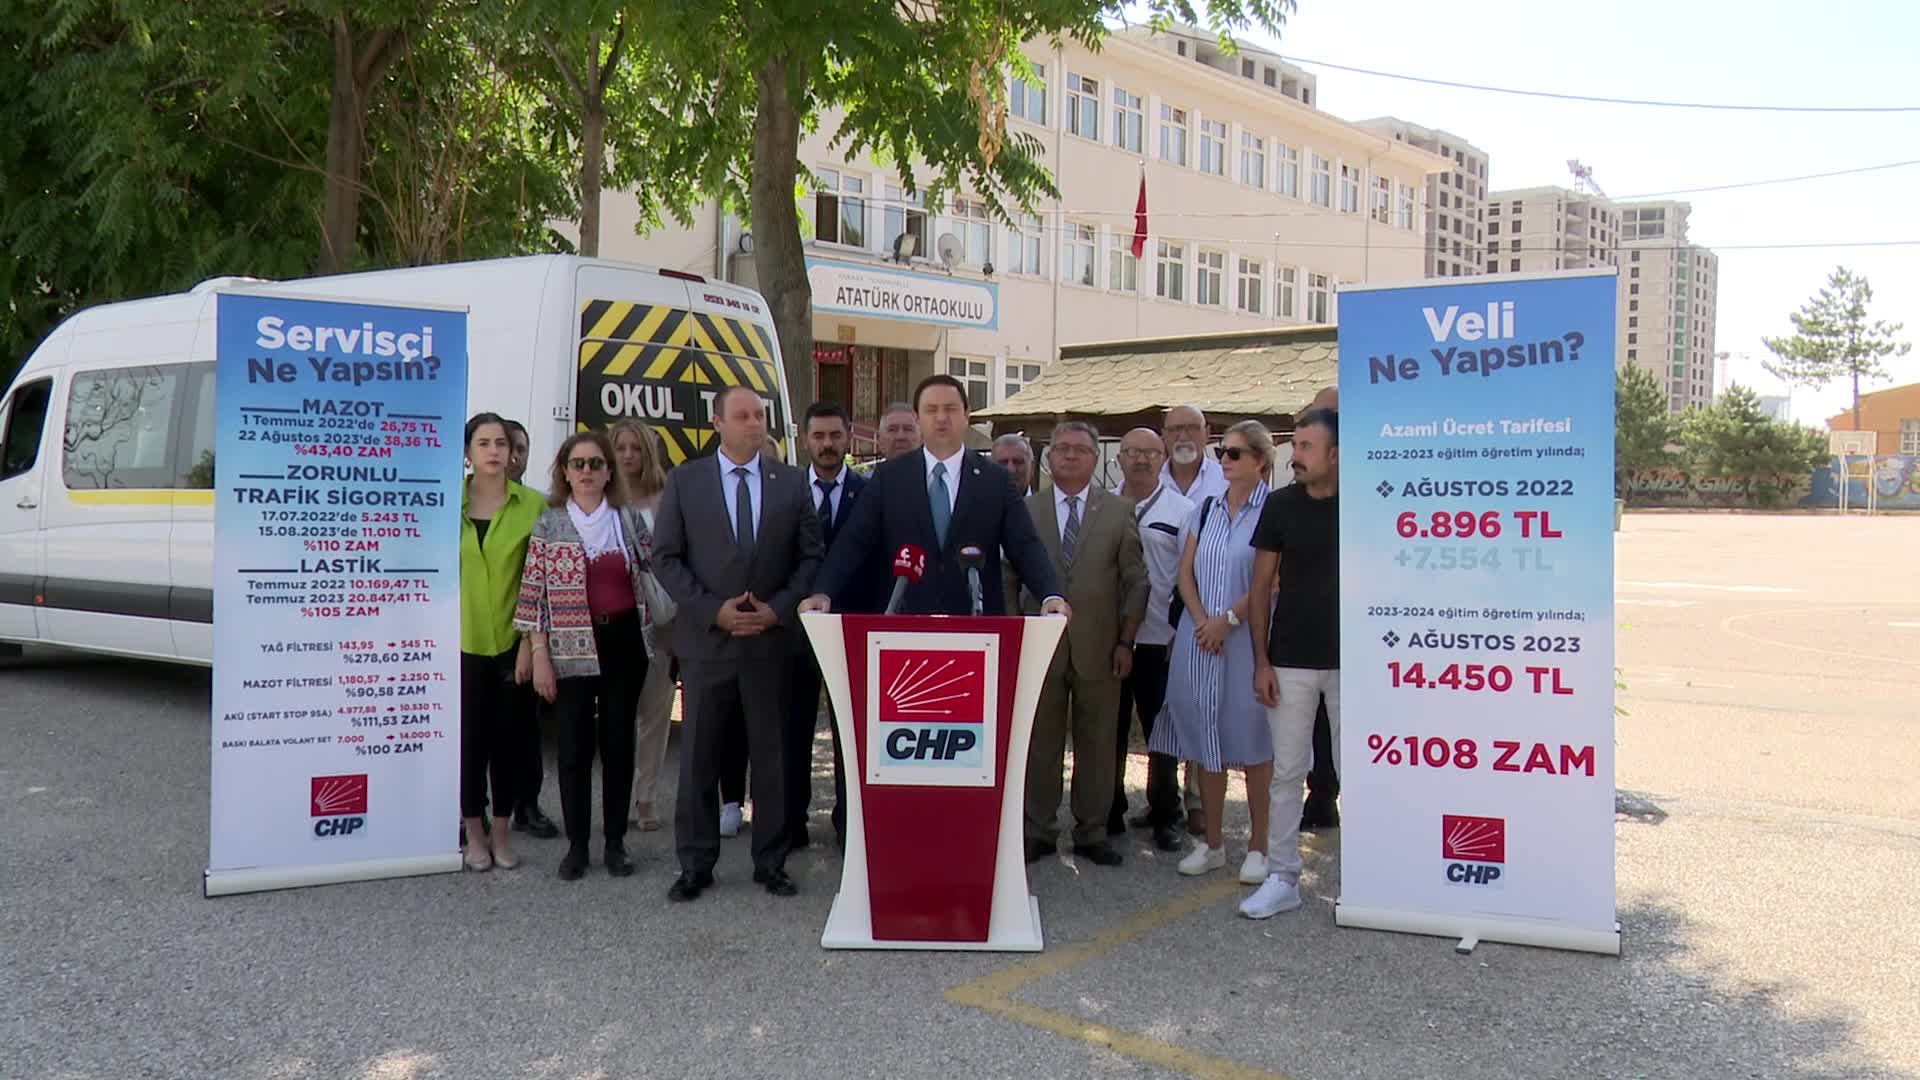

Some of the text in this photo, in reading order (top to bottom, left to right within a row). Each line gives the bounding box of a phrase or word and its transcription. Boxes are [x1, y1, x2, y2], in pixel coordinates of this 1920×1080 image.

[836, 284, 983, 320] ATATÜRK ORTAOKULU
[1422, 301, 1514, 342] Veli
[256, 316, 432, 363] Servisçi
[1369, 332, 1584, 384] Ne Yapsın?
[248, 356, 441, 386] Ne Yapsın?
[302, 399, 384, 417] MAZOT
[601, 383, 684, 420] OKUL
[243, 415, 437, 433] 1 Temmuz 2022'de 26,75 TL
[1380, 416, 1571, 437] Azami Ücret Tarifesi
[239, 431, 441, 448] 22 Ağustos 2023'de 38,36 TL
[295, 445, 391, 458] %43,40 ZAM
[1367, 447, 1584, 460] 2022-2023 eğitim öğretim yılında;
[287, 465, 397, 482] ZORUNLU
[1402, 477, 1574, 497] AĞUSTOS 2022
[233, 485, 444, 507] TRAFİK SİGORTASI
[262, 511, 419, 522] 17.07.2022'de 5.243 TL
[1396, 511, 1562, 538] 6.896 TL
[259, 526, 420, 537] 15.08.2023'de 11.010 TL
[304, 540, 379, 551] %110 ZAM
[301, 556, 381, 573] LASTİK
[1394, 548, 1553, 571] +7.554 TL
[248, 579, 429, 590] Temmuz 2022 10.169,47 TL
[247, 593, 430, 604] Temmuz 2023 20.847,41 TL
[301, 607, 380, 617] %105 ZAM
[1368, 607, 1584, 621] 2023-2024 eğitim öğretim yılında;
[261, 640, 437, 653] YAĞ FİLTRESİ 143,95 545 TL
[1408, 629, 1581, 653] AĞUSTOS 2023
[343, 652, 431, 664] %278,60 ZAM
[243, 679, 283, 689] MAZOT
[286, 677, 333, 687] FİLTRESİ
[400, 672, 429, 682] 2.250
[433, 672, 445, 681] TL
[1388, 662, 1574, 695] 14.450 TL
[346, 686, 426, 698] %90,58 ZAM
[224, 711, 244, 721] AKÜ
[247, 711, 283, 721] (START
[286, 711, 308, 719] STOP
[351, 715, 430, 727] %111,53 ZAM
[222, 739, 247, 748] BASKI
[250, 738, 280, 747] BALATA
[337, 735, 364, 743] 7.000
[399, 731, 430, 740] 14.000
[886, 728, 976, 760] CHP
[355, 743, 423, 755] %100 ZAM
[1368, 734, 1595, 776] %108 ZAM
[314, 817, 363, 837] CHP
[1447, 863, 1500, 884] CHP
